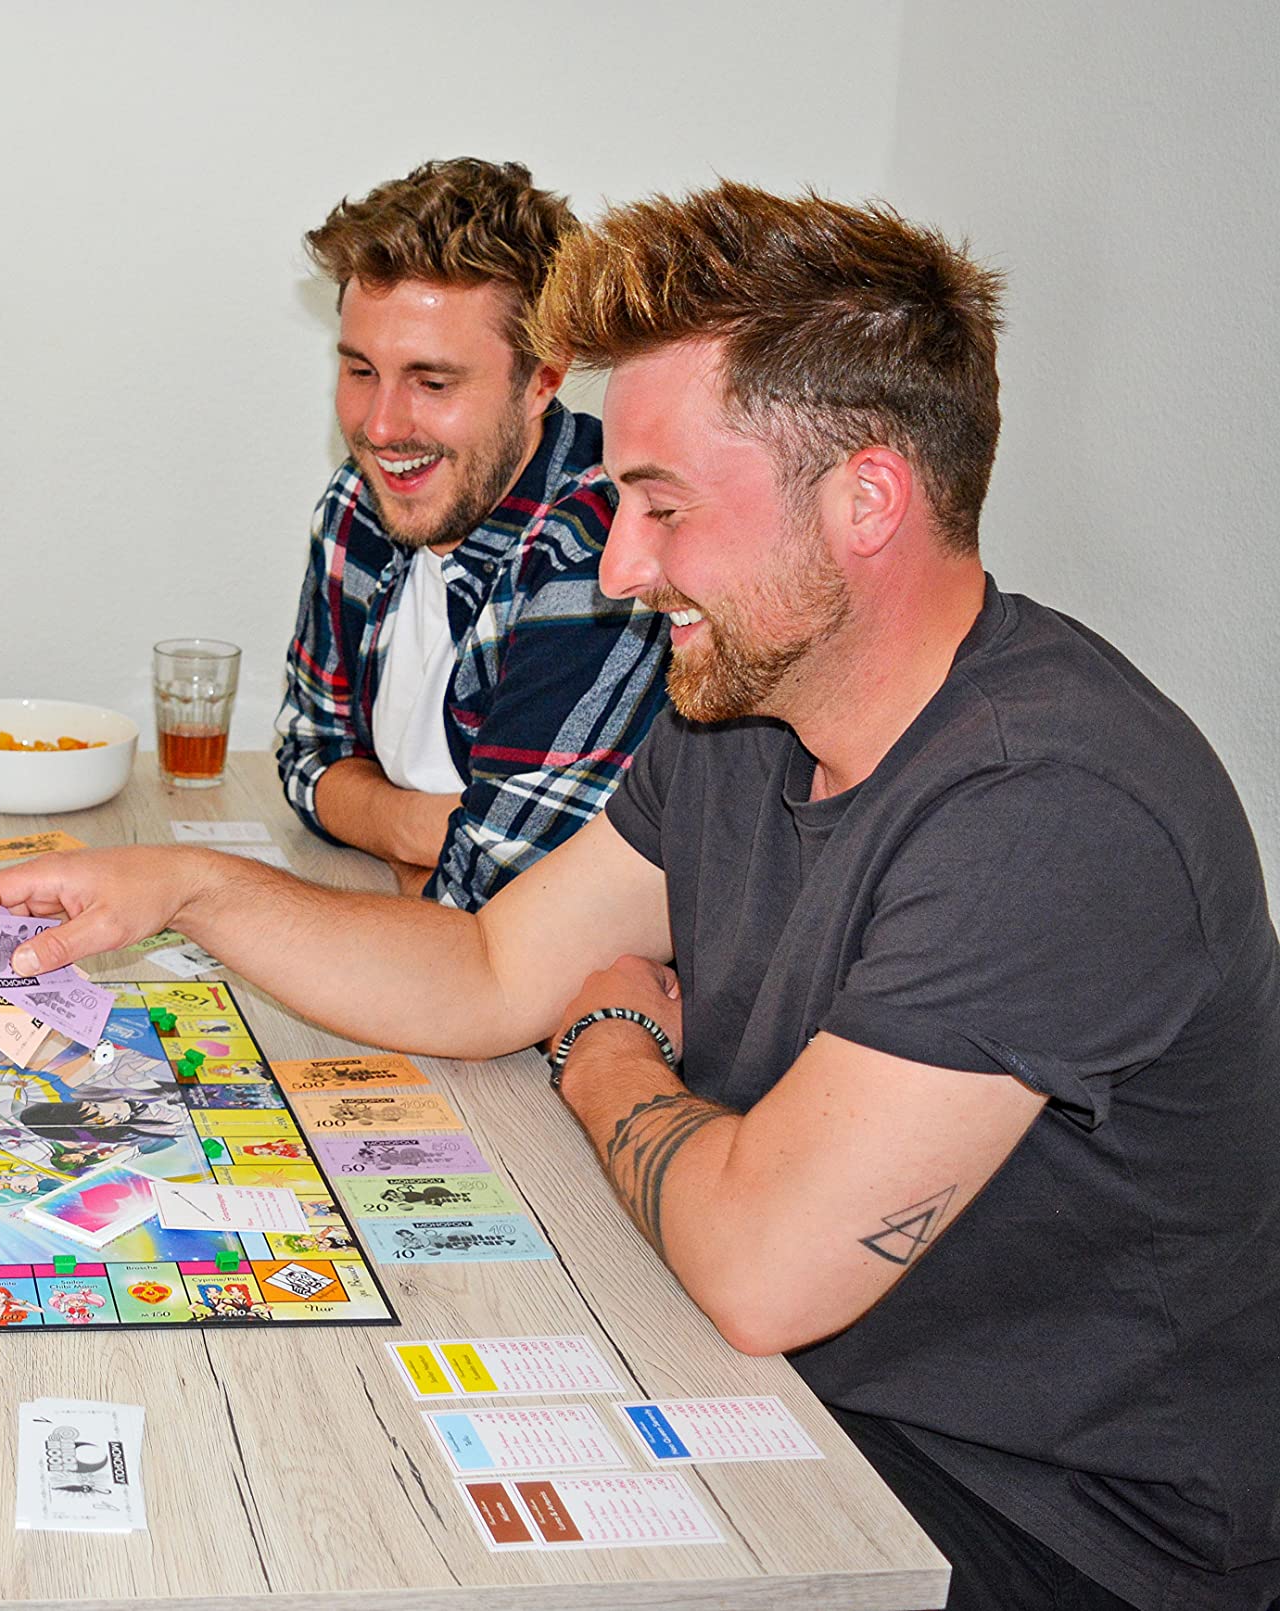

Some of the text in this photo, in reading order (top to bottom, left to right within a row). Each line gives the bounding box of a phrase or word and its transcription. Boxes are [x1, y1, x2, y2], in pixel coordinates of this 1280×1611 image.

[292, 1081, 326, 1090] 500
[314, 1119, 347, 1128] 100
[341, 1164, 366, 1173] 50
[363, 1203, 390, 1213] 20
[489, 1224, 517, 1236] 10
[392, 1249, 416, 1259] 10
[108, 1441, 129, 1485] MONOPOLY
